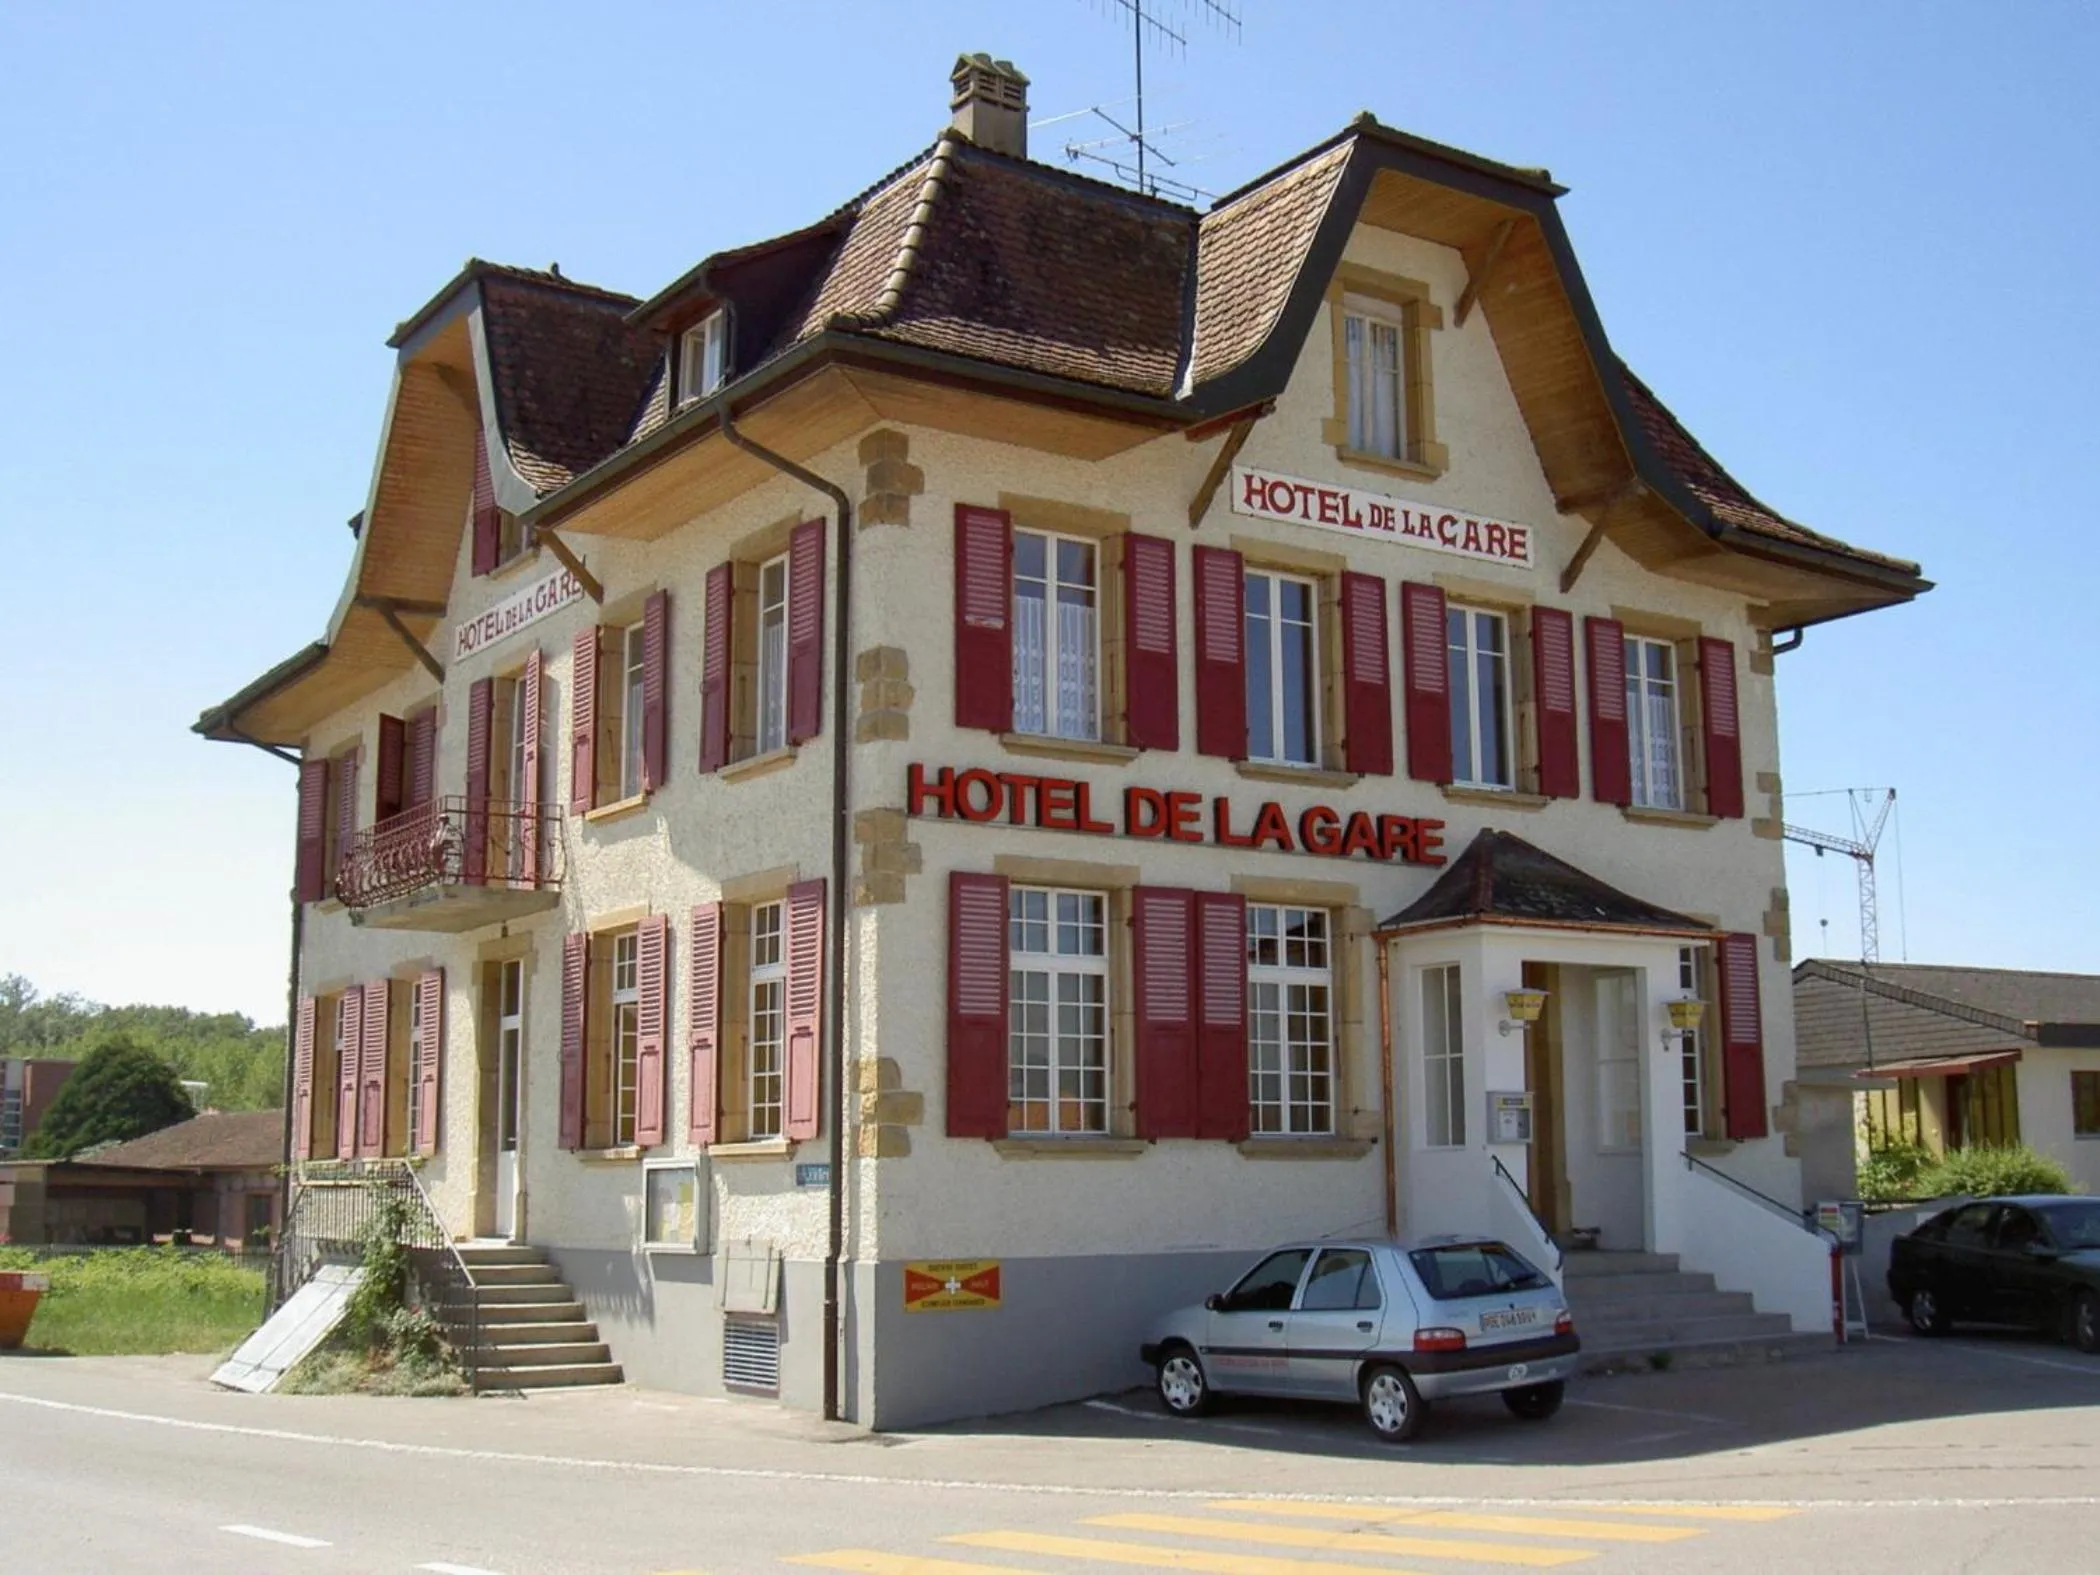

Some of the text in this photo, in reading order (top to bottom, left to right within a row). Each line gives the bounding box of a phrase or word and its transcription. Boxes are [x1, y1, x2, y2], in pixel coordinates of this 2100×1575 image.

[1243, 474, 1364, 529] HOTEL
[1368, 502, 1396, 532] DE
[1402, 510, 1435, 540] LA
[456, 607, 504, 657] HOTEL
[505, 606, 518, 631] DE
[519, 597, 534, 623] LA
[907, 763, 1448, 866] HOTEL DE LA GARE
